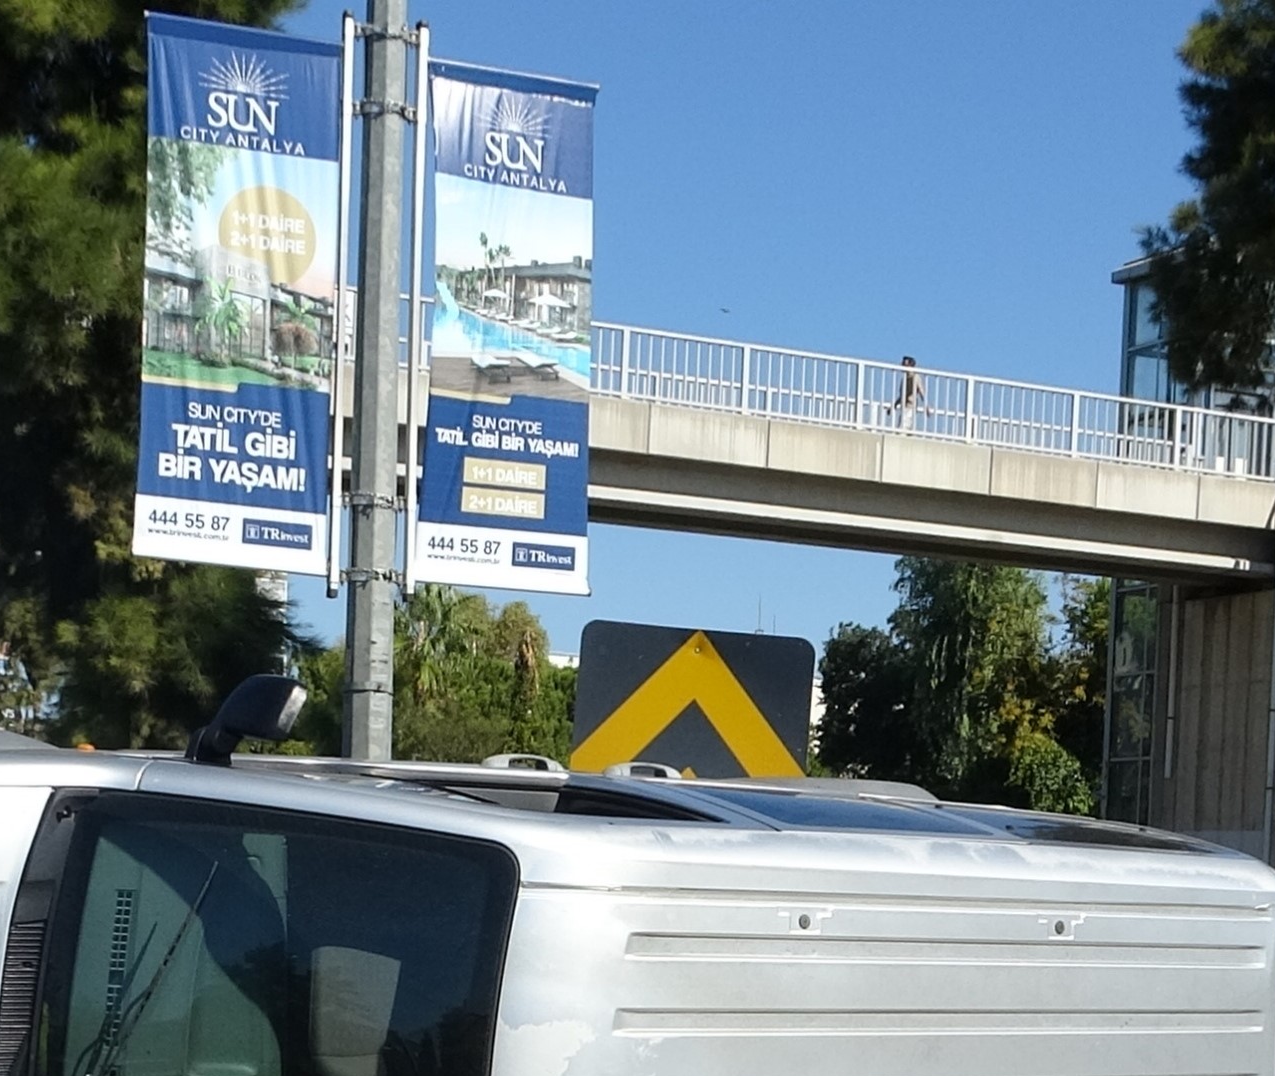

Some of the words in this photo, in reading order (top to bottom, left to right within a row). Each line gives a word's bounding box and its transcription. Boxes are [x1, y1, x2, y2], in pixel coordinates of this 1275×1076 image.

[207, 92, 279, 136] SUN
[180, 126, 219, 143] CITY
[225, 132, 305, 156] ANTALYA
[485, 131, 544, 173] SUN
[464, 164, 495, 182] CITY
[500, 170, 567, 193] ANTALYA
[231, 210, 256, 228] 1+1
[258, 213, 306, 234] DAİRE
[230, 231, 256, 249] 2+1
[258, 234, 306, 255] DAİRE
[188, 402, 220, 421] SUN
[223, 406, 281, 428] CITY'DE
[472, 415, 497, 429] SUN
[171, 421, 238, 454] TATİL
[244, 427, 296, 460] GİBİ
[435, 427, 468, 446] TATİL
[471, 430, 499, 449] GİBİ
[501, 432, 525, 452] BİR
[527, 438, 580, 459] YAŞAM!
[158, 449, 202, 481] BİR
[208, 458, 306, 493] YAŞAM!
[471, 465, 493, 480] 1+1
[495, 467, 538, 486] DAİRE
[469, 495, 493, 510] 2+1
[495, 496, 538, 515] DAİRE
[148, 509, 178, 526] 444
[184, 513, 205, 529] 55
[211, 515, 230, 531] 87
[427, 536, 454, 551] 444
[460, 538, 478, 553] 55
[483, 540, 501, 555] 87
